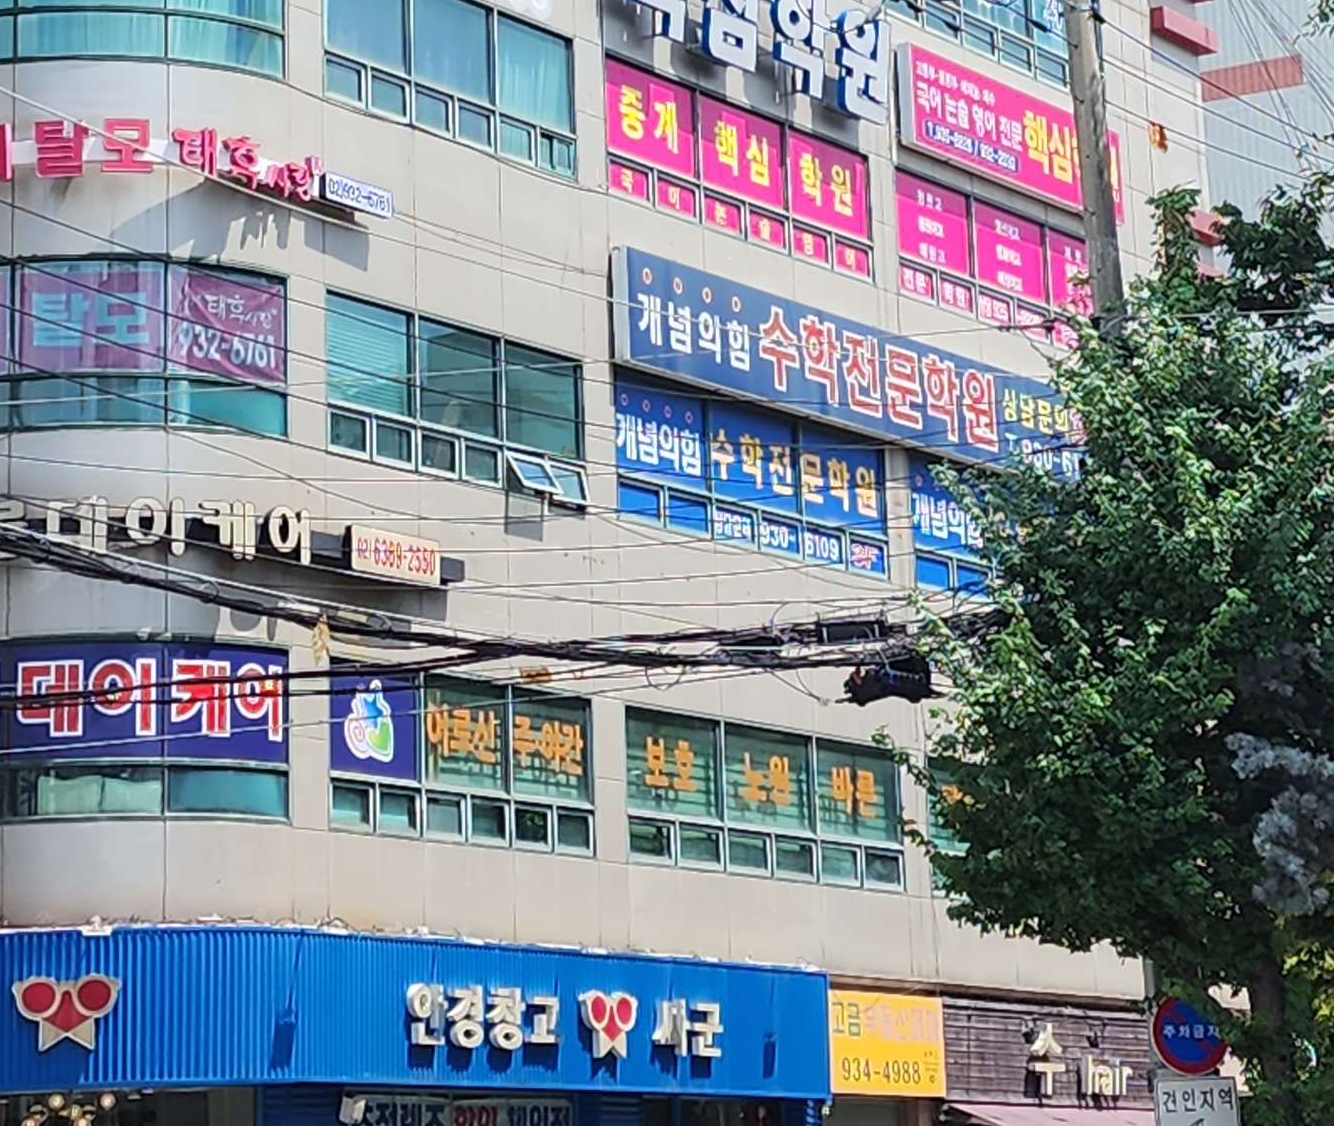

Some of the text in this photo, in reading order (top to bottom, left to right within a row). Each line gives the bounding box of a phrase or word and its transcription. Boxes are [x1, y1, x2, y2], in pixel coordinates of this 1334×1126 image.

[35, 117, 153, 177] 탈모
[619, 85, 854, 217] 중계 핵심 학원
[32, 291, 151, 351] 탈모
[638, 291, 750, 372] 개념의힘
[758, 305, 1000, 453] 수학전문학원
[616, 411, 701, 476] 개념의힘
[426, 703, 498, 763] 어르신
[645, 737, 697, 792] 보호
[744, 753, 791, 806] 노원
[832, 767, 877, 817] 바른
[406, 982, 561, 1051] 안경창고
[1163, 1023, 1221, 1041] 주차금지
[841, 1057, 922, 1085] 934-4988
[1029, 1022, 1133, 1097] 수 hair
[1161, 1087, 1235, 1114] 견인지역
